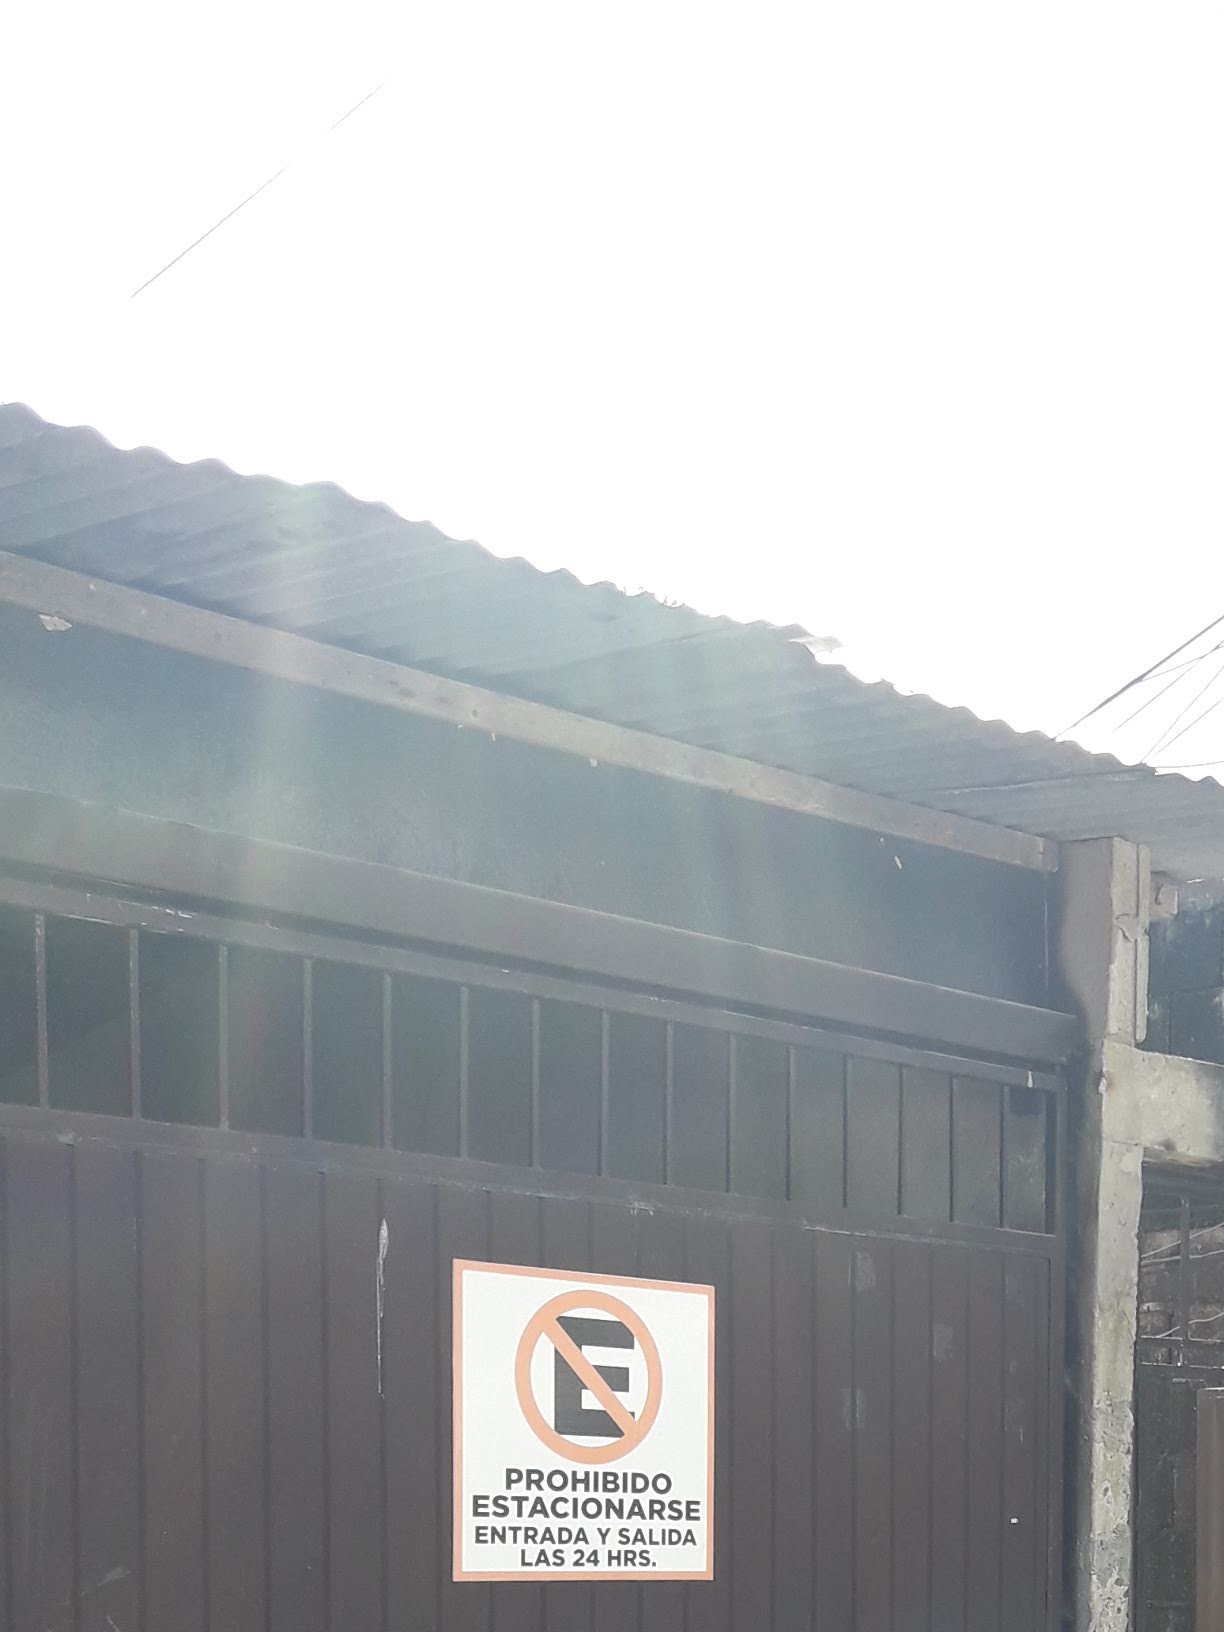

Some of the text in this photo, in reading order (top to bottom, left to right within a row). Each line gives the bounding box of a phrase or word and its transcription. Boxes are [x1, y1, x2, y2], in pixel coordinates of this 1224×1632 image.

[505, 1467, 673, 1495] PROHIBIDO
[472, 1494, 701, 1521] ESTACIONARSE
[474, 1525, 697, 1546] ENTRADA Y SALIDA
[520, 1548, 657, 1567] LAS 24 HRS.
